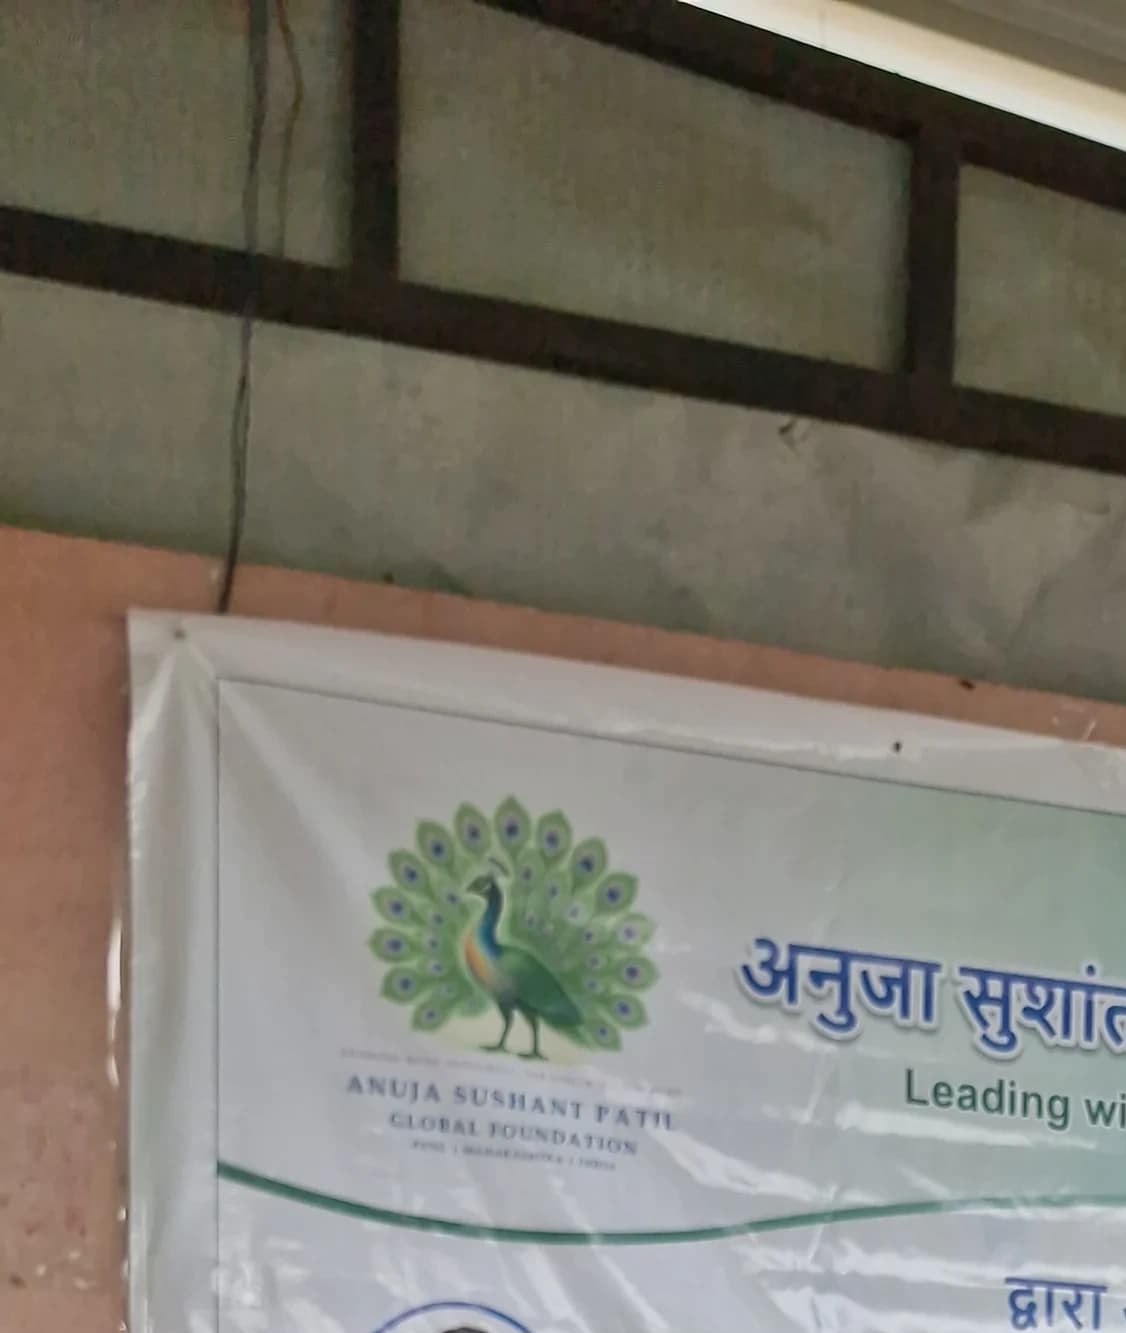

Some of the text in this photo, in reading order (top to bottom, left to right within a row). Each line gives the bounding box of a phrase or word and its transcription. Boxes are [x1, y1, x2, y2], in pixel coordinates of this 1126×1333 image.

[741, 937, 940, 1032] अनुजा
[346, 1074, 442, 1103] ANUJA
[453, 1085, 583, 1120] SUSHANT
[905, 1069, 1070, 1131] Leading
[389, 1111, 638, 1155] GLOBAL FOUNDATION
[1004, 1276, 1106, 1331] द्वारा
